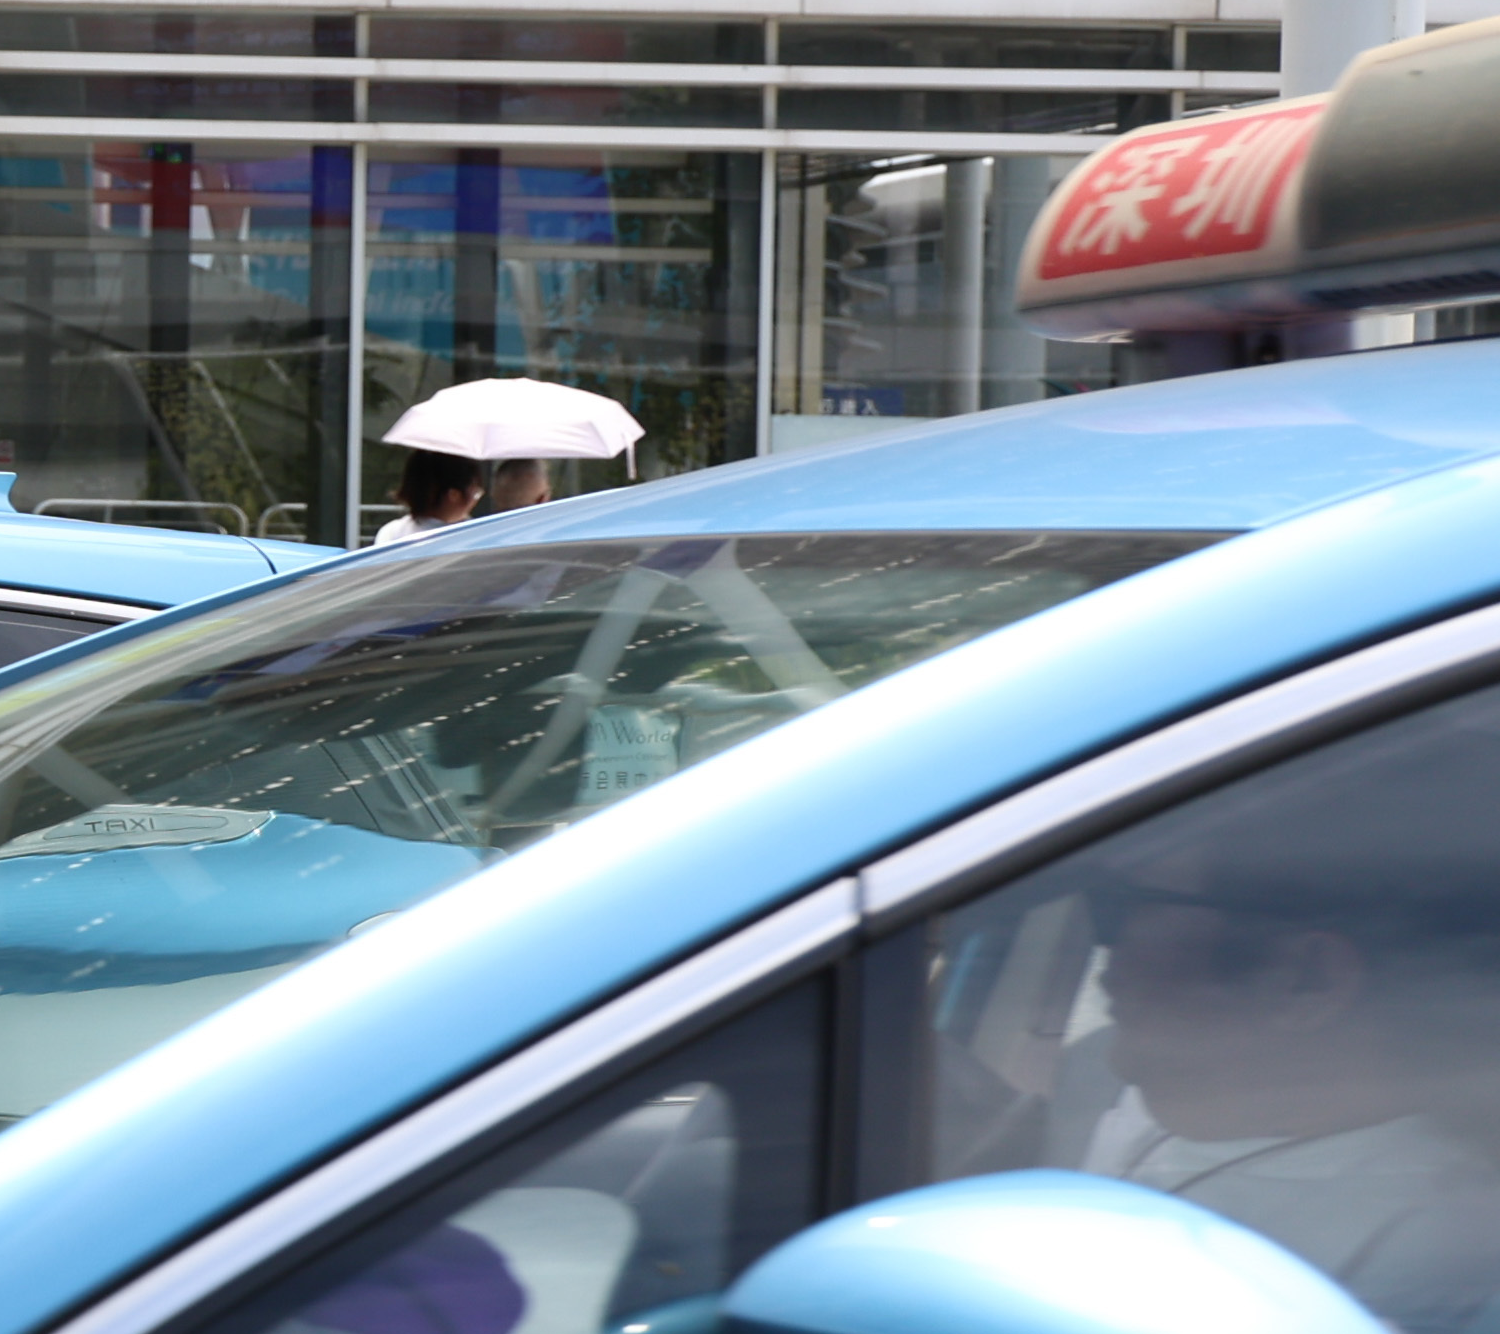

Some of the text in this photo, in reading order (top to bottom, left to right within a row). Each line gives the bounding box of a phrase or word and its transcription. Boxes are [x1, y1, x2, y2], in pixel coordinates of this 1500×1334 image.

[1056, 116, 1320, 255] 深圳
[610, 719, 672, 745] World
[83, 817, 155, 833] TAXI
